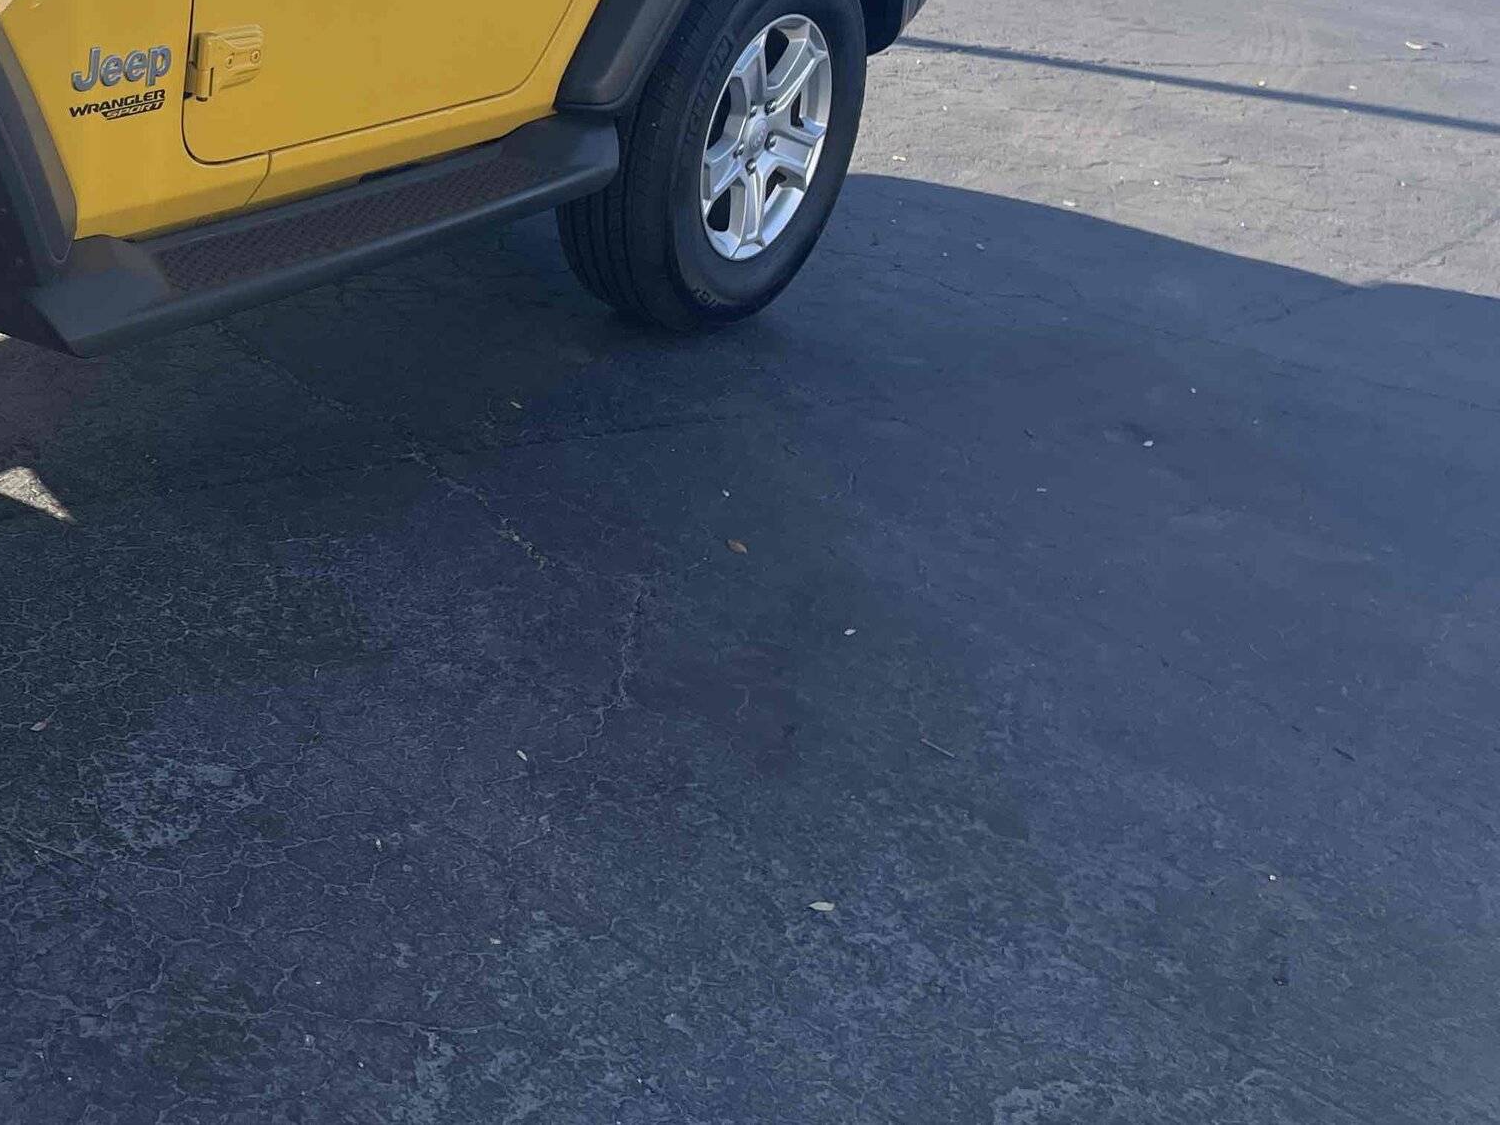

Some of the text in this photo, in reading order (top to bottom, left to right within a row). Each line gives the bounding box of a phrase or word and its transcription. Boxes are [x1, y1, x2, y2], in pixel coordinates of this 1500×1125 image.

[72, 46, 171, 92] Jeep
[69, 89, 165, 117] WRANGLER
[104, 102, 164, 119] SPORT
